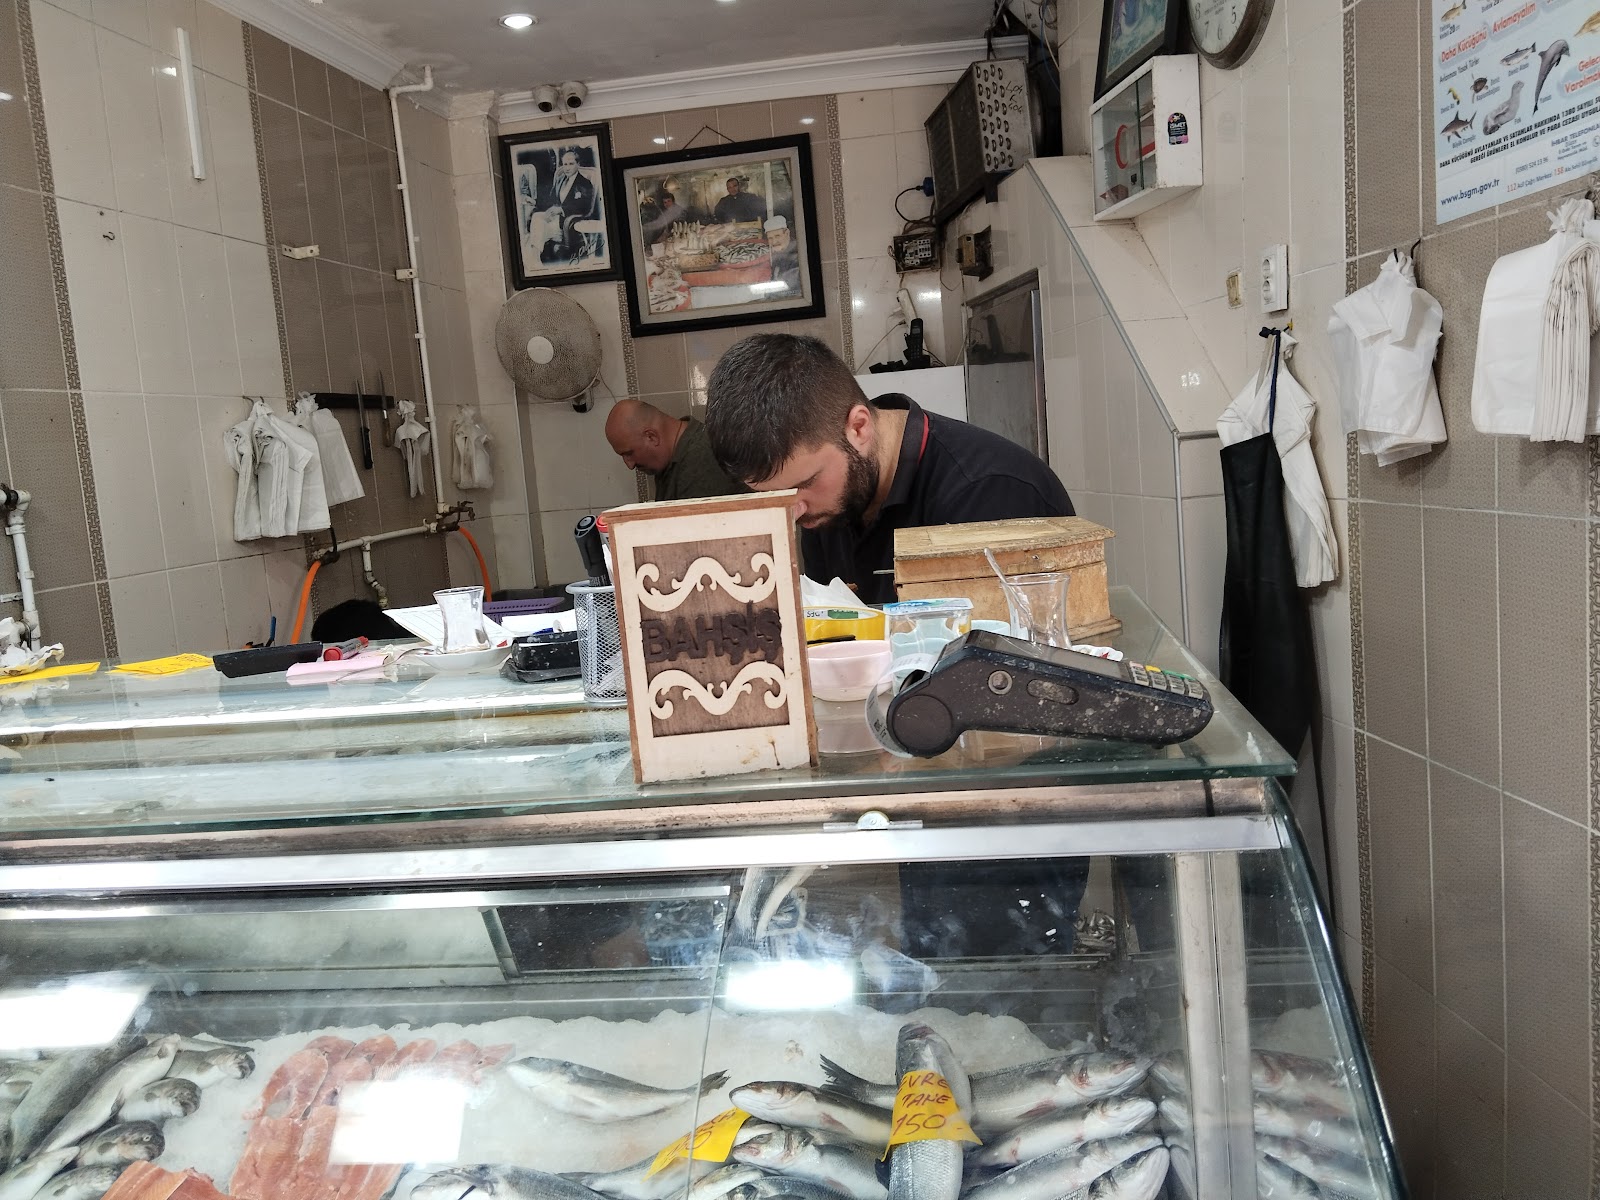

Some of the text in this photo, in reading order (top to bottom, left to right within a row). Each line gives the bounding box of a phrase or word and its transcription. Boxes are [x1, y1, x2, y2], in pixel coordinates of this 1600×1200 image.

[1204, 20, 1209, 38] 7
[1231, 5, 1237, 24] 5
[1492, 2, 1536, 34] Avlamayalım
[1441, 26, 1487, 63] Daha Küçüğünü
[1474, 137, 1502, 155] AVLAYANLAR
[1509, 125, 1533, 140] SATANLAR
[1534, 113, 1560, 129] HAKKINDA
[1516, 131, 1539, 146] KONULUR
[1547, 121, 1561, 132] PARA
[1440, 178, 1500, 206] www.bsgm.gov.tr
[640, 600, 783, 666] BAHŞİŞ
